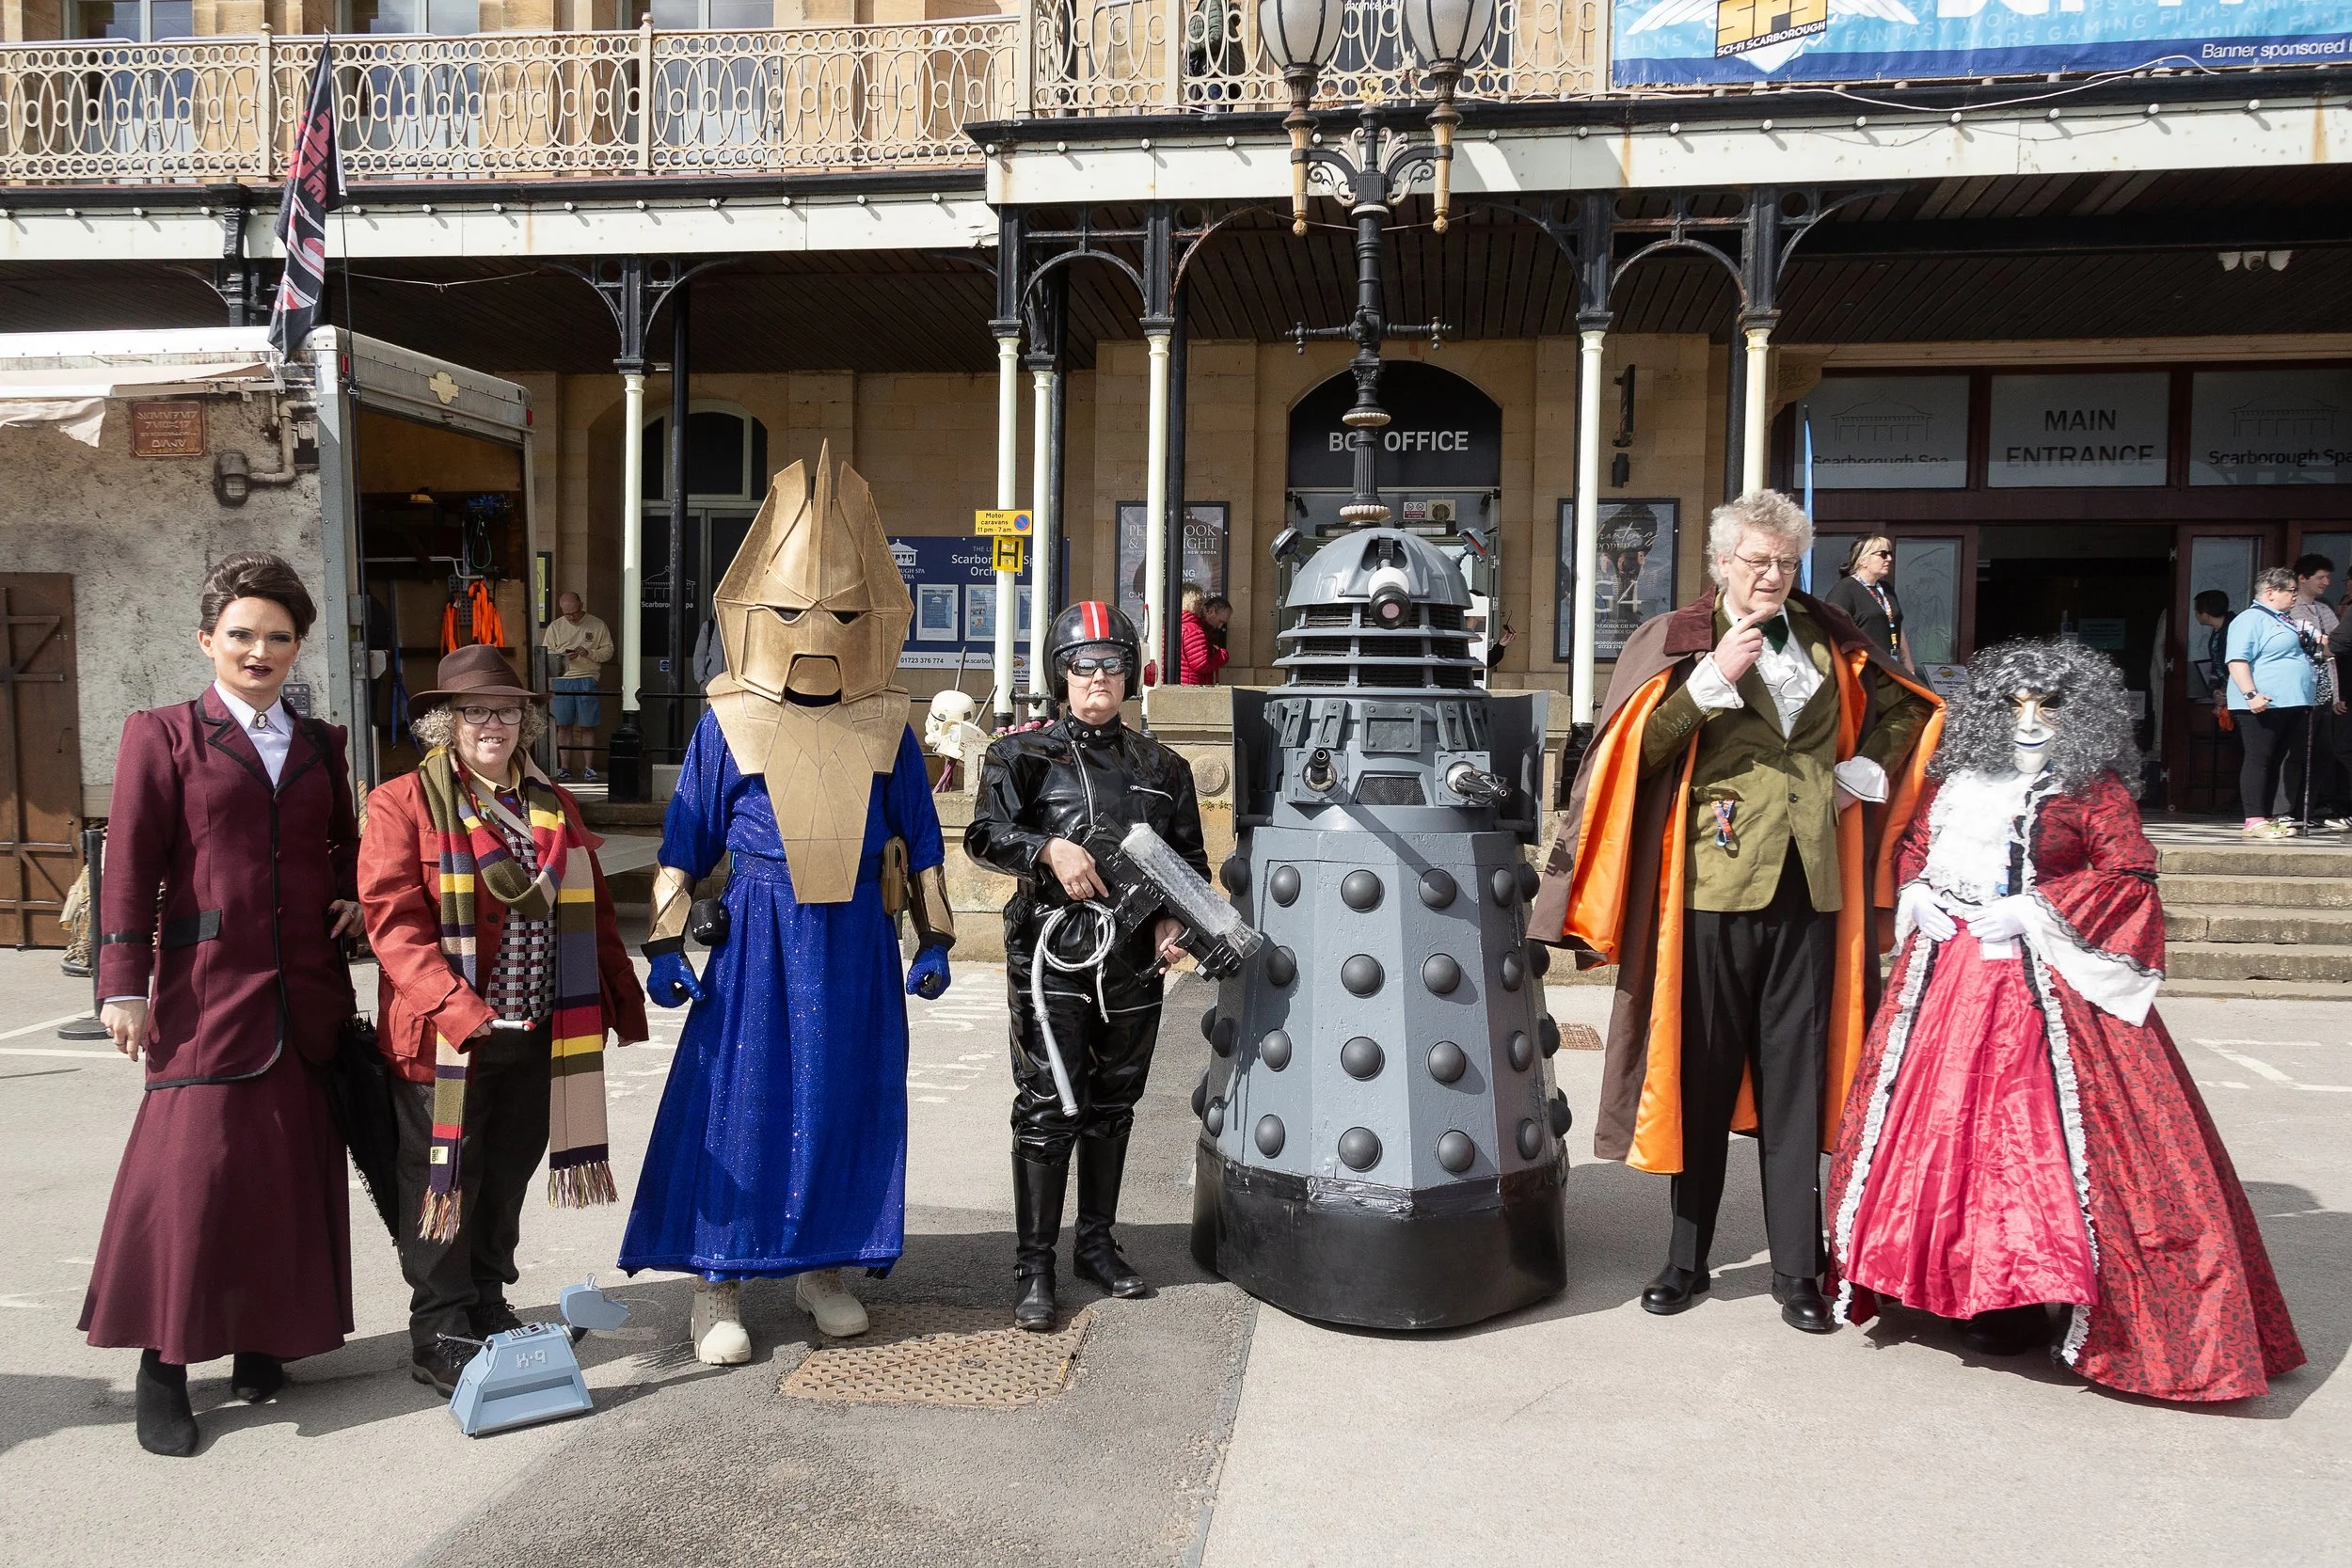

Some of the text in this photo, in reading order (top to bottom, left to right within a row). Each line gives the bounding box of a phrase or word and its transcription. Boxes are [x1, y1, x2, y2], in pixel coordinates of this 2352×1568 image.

[2047, 13, 2148, 42] GAMING
[2160, 4, 2233, 26] FILMS
[1616, 33, 1684, 54] FILMS
[1716, 43, 1745, 57] SCI-FI
[1746, 20, 1826, 50] SCARBOROUGH
[1845, 21, 1950, 46] FANTASY
[2201, 40, 2344, 59] Banner sponsored
[2044, 409, 2117, 432] MAIN
[1384, 431, 1470, 451] OFFICE
[1812, 453, 1949, 470] Scarborough Spa
[2006, 445, 2155, 467] ENTRANCE
[2208, 449, 2352, 468] Scarborough Spa
[1184, 524, 1216, 536] OOK
[1183, 537, 1217, 549] IGHT
[951, 553, 993, 564] Scarbor
